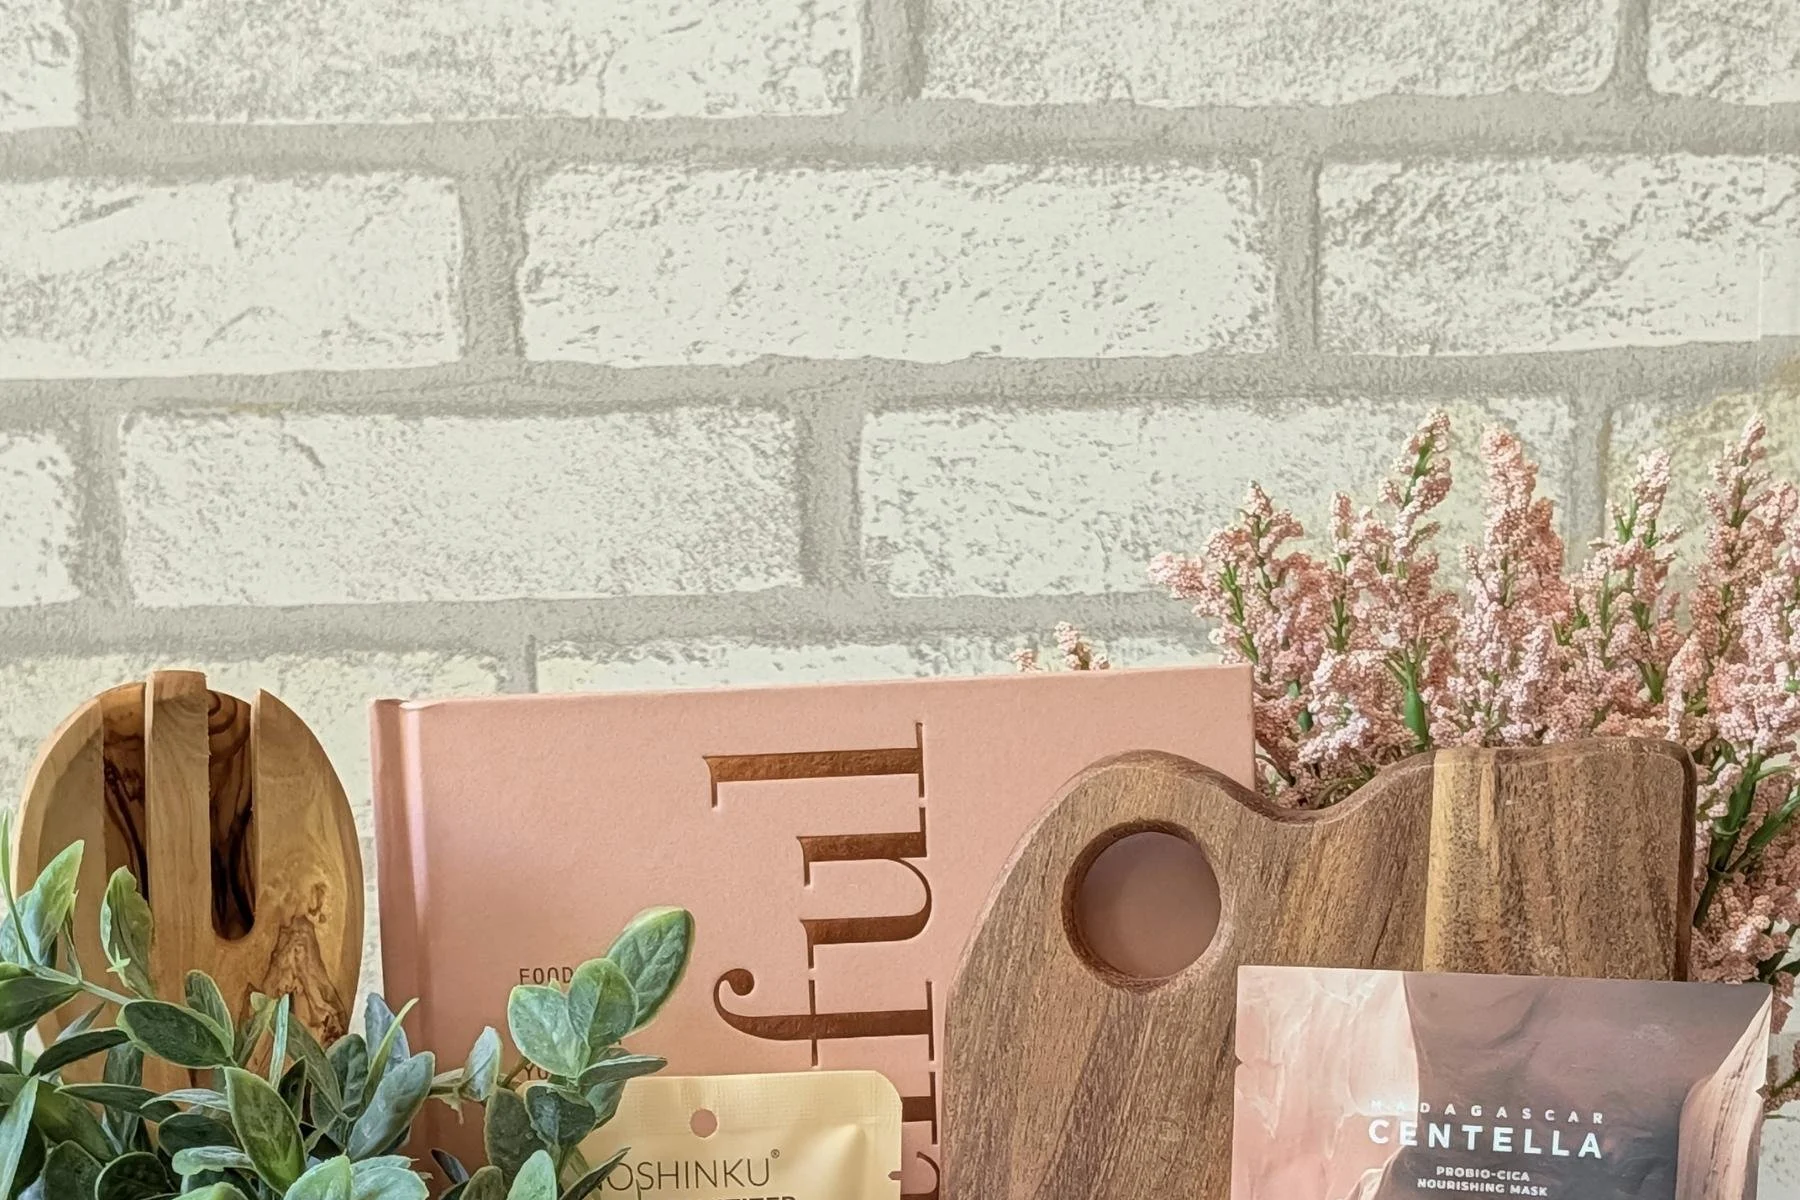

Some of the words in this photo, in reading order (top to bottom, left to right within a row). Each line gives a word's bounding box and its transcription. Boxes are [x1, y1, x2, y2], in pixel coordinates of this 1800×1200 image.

[1371, 1100, 1603, 1125] MADAGASCAR
[1368, 1119, 1603, 1159] CENTELLA
[1436, 1166, 1530, 1182] PROBIO-CICA
[1417, 1178, 1505, 1193] NOURISHING
[1510, 1184, 1548, 1197] MASK
